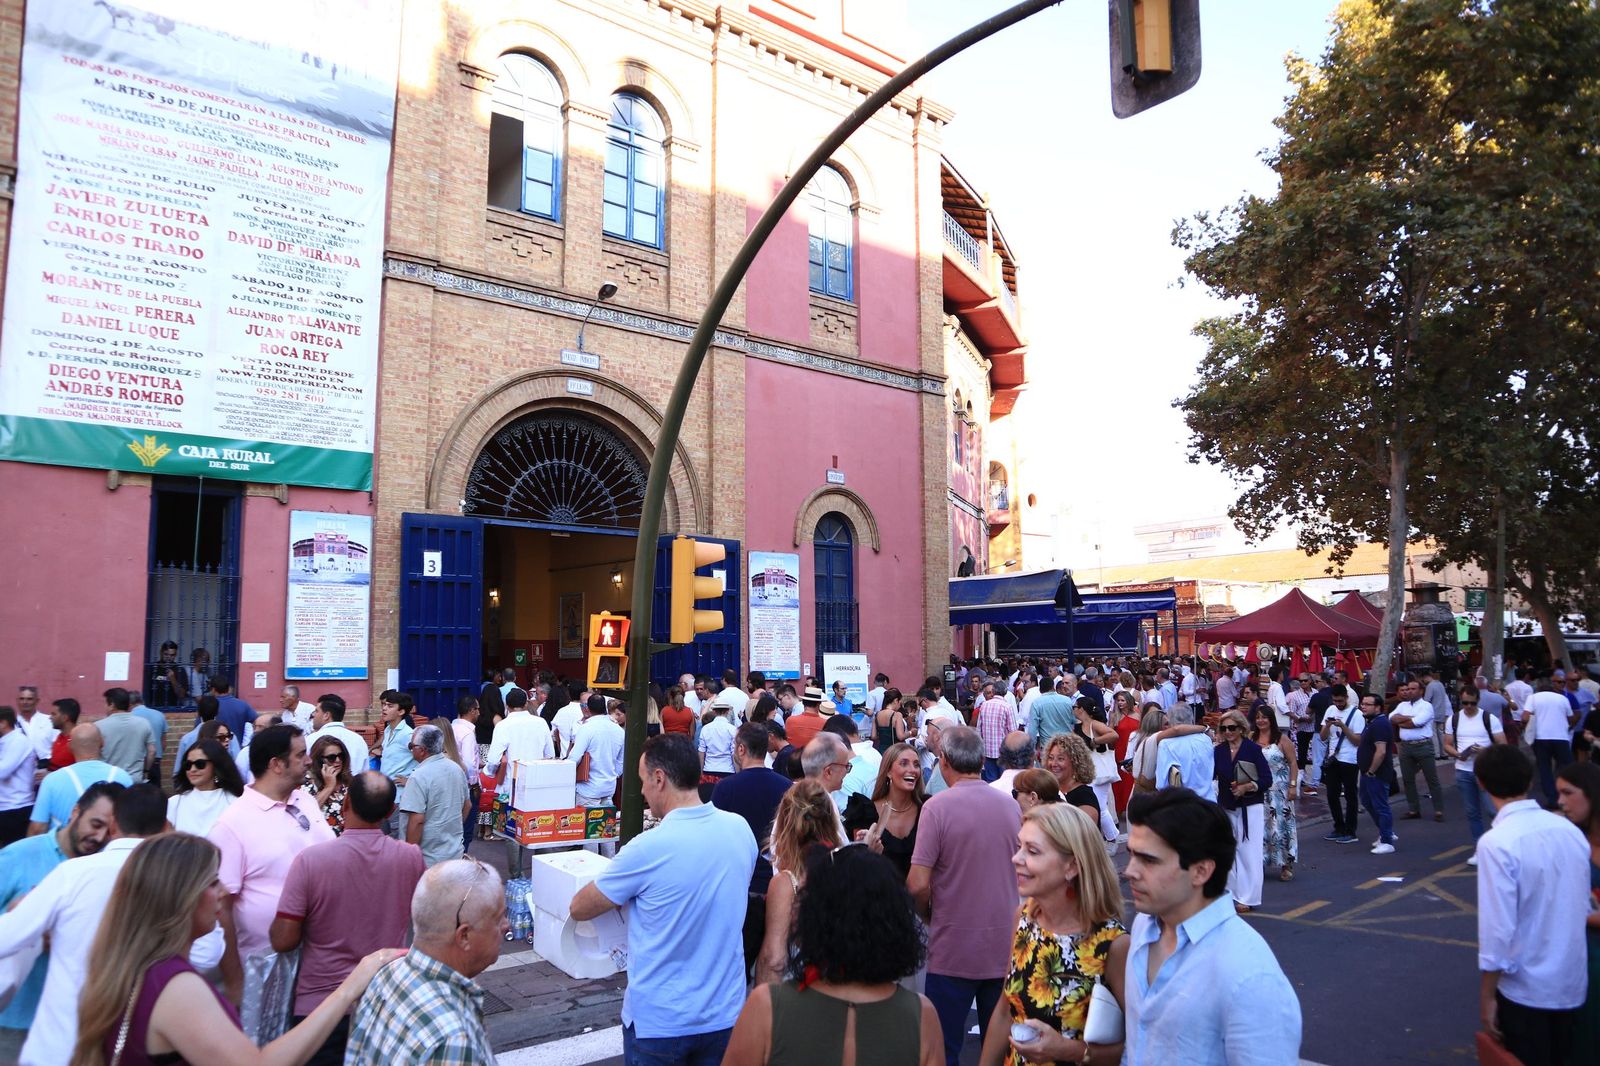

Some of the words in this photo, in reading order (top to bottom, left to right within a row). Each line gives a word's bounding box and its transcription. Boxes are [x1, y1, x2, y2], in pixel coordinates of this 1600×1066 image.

[62, 56, 104, 72] TODOS
[107, 68, 129, 79] LOS
[133, 74, 189, 94] FESTEJOS
[278, 113, 297, 124] LAS
[307, 121, 320, 130] DE
[322, 126, 334, 135] LA
[336, 130, 367, 145] TARDE
[94, 76, 155, 102] MARTES
[160, 95, 174, 106] 30
[178, 99, 197, 111] DE
[200, 104, 240, 123] JULIO
[248, 117, 282, 134] CLASE
[142, 144, 177, 160] CABAS
[185, 153, 216, 168] JAIME
[219, 161, 259, 178] PADILLA
[266, 174, 293, 187] JULIO
[178, 139, 234, 161] GUILLERMO
[237, 154, 263, 167] LUNA
[313, 175, 324, 183] DE
[327, 178, 364, 195] ANTONIO
[108, 184, 141, 198] LUIS
[145, 192, 202, 210] PEREDA
[146, 182, 208, 202] Picadores
[152, 174, 170, 183] DE
[174, 178, 215, 194] JULIO
[45, 182, 117, 208] JAVIER
[124, 198, 209, 228] ZULUETA
[237, 192, 287, 210] JUEVES
[300, 208, 315, 217] DE
[320, 213, 365, 229] AGOSTO
[54, 202, 143, 233] ENRIQUE
[149, 221, 200, 242] TORO
[253, 206, 298, 221] Corrida
[301, 217, 314, 225] de
[316, 221, 346, 233] Toros
[47, 218, 126, 246] CARLOS
[131, 235, 204, 260] TIRADO
[227, 230, 273, 250] DAVID
[277, 241, 295, 255] DE
[299, 246, 361, 269] MIRANDA
[42, 238, 110, 257] VIERNES
[126, 254, 145, 263] DE
[149, 258, 207, 275] AGOSTO
[64, 252, 119, 268] Corrida
[124, 264, 139, 272] de
[142, 267, 180, 279] Toros
[256, 252, 307, 268] VICTORINO
[41, 270, 122, 295] MORANTE
[127, 289, 142, 298] DE
[146, 292, 158, 301] LA
[162, 294, 202, 308] PUEBLA
[83, 266, 175, 289] ZALDUENDO
[240, 295, 270, 305] JUAN
[273, 301, 307, 312] PEDRO
[311, 307, 352, 321] DOMECQ
[249, 286, 293, 300] Corrida
[296, 295, 308, 303] de
[315, 298, 343, 309] Toros
[297, 287, 312, 295] DE
[319, 290, 364, 304] AGOSTO
[46, 293, 89, 308] MIGUEL
[134, 305, 196, 325] PERERA
[226, 305, 284, 323] ALEJANDRO
[287, 313, 361, 336] TALAVANTE
[61, 311, 124, 332] DANIEL
[128, 321, 180, 343] LUQUE
[245, 323, 285, 340] JUAN
[290, 330, 343, 349] ORTEGA
[31, 327, 106, 345] DOMINGO
[123, 340, 142, 349] DE
[146, 344, 204, 358] AGOSTO
[39, 350, 52, 358] D.
[48, 341, 105, 355] Corrida
[109, 350, 125, 358] de
[129, 352, 181, 366] Rejones
[259, 342, 299, 359] ROCA
[303, 349, 329, 363] REY
[49, 363, 101, 381] DIEGO
[106, 370, 183, 391] VENTURA
[231, 355, 272, 365] VENTA
[275, 361, 317, 373] ONLINE
[320, 368, 354, 378] DESDE
[292, 371, 327, 381] JUNIO
[44, 375, 114, 398] ANDRÉS
[118, 387, 184, 406] ROMERO
[219, 368, 363, 393] WWW.TOROSPEREDA.COM
[256, 388, 277, 396] 959
[281, 391, 299, 400] 281
[304, 395, 324, 403] 500
[179, 445, 218, 459] CAJA
[221, 447, 275, 464] RURAL
[209, 461, 228, 469] DEL
[230, 462, 250, 471] SUR
[429, 560, 436, 573] 3
